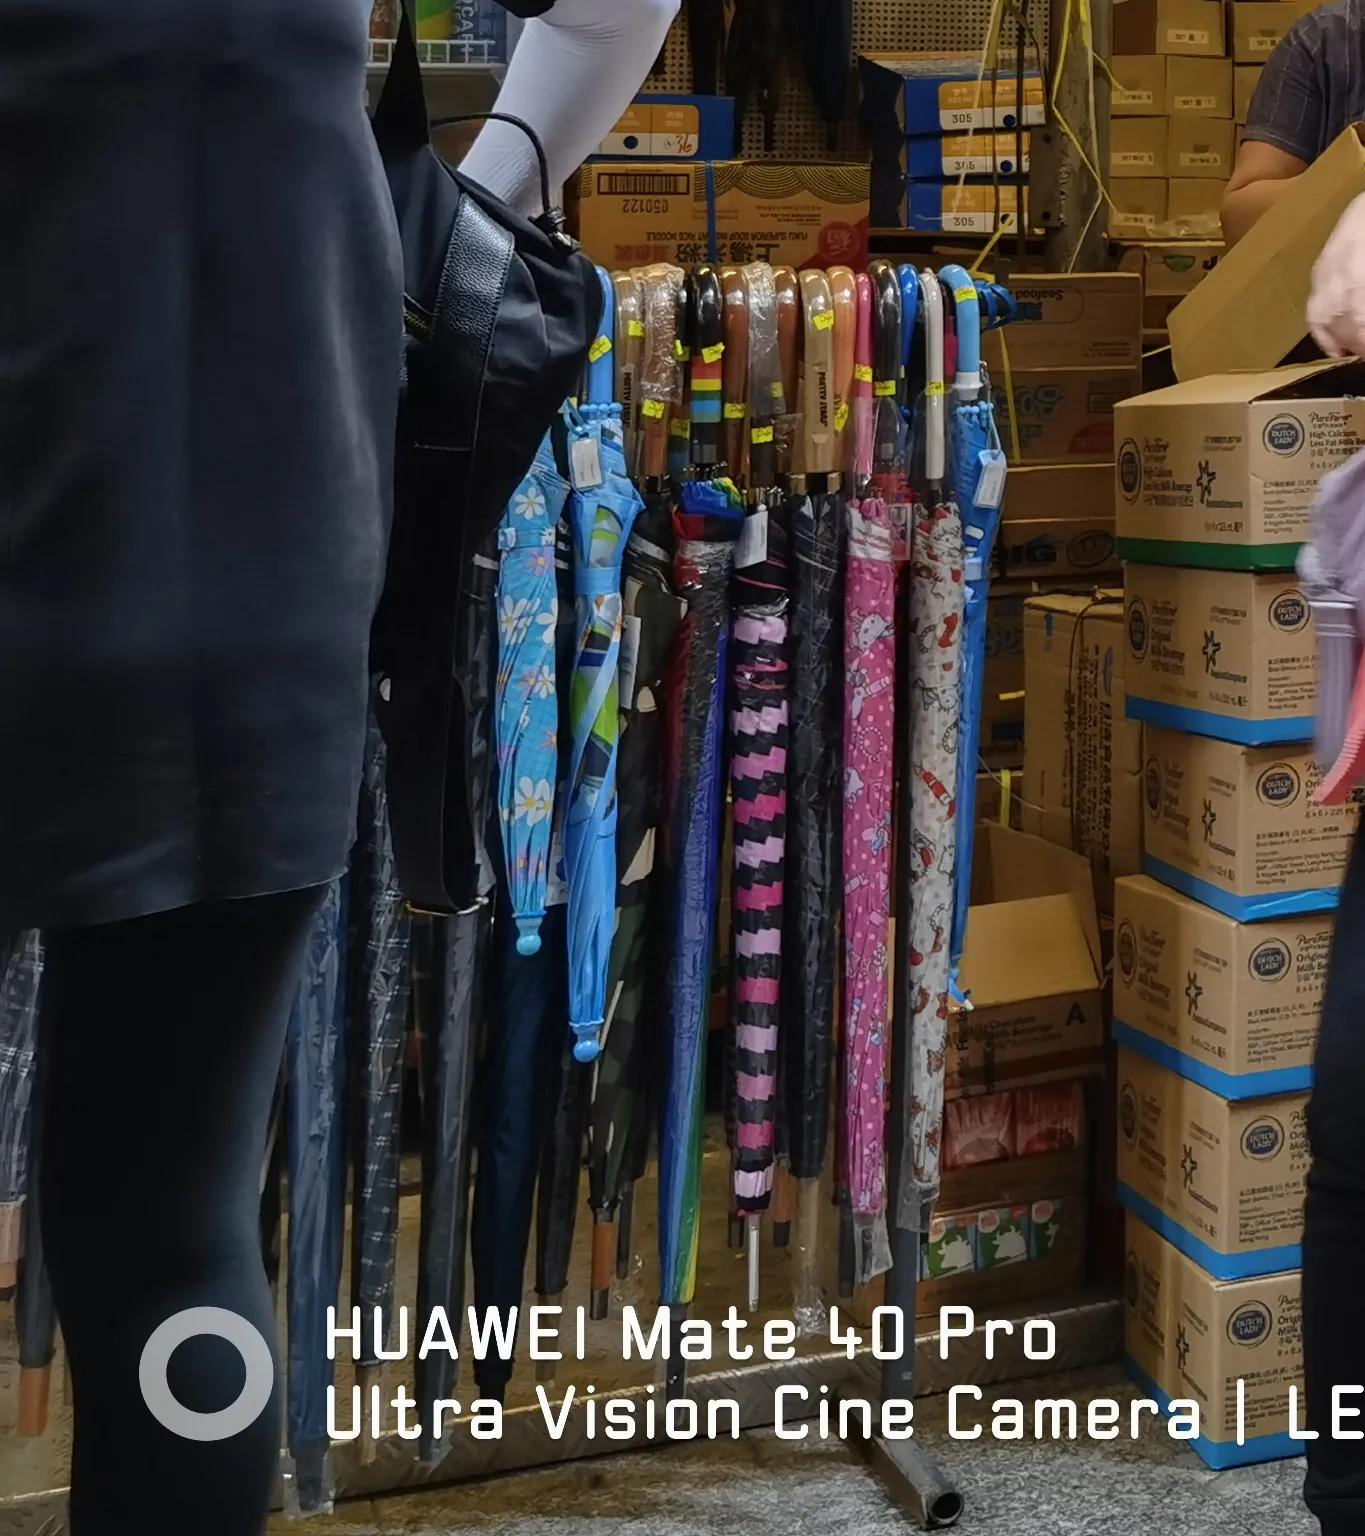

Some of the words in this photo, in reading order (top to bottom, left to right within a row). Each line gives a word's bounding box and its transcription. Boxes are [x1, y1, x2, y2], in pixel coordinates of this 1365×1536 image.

[952, 114, 972, 124] 305
[954, 216, 975, 227] 305
[1015, 288, 1064, 301] Seafood
[1065, 1002, 1085, 1027] A
